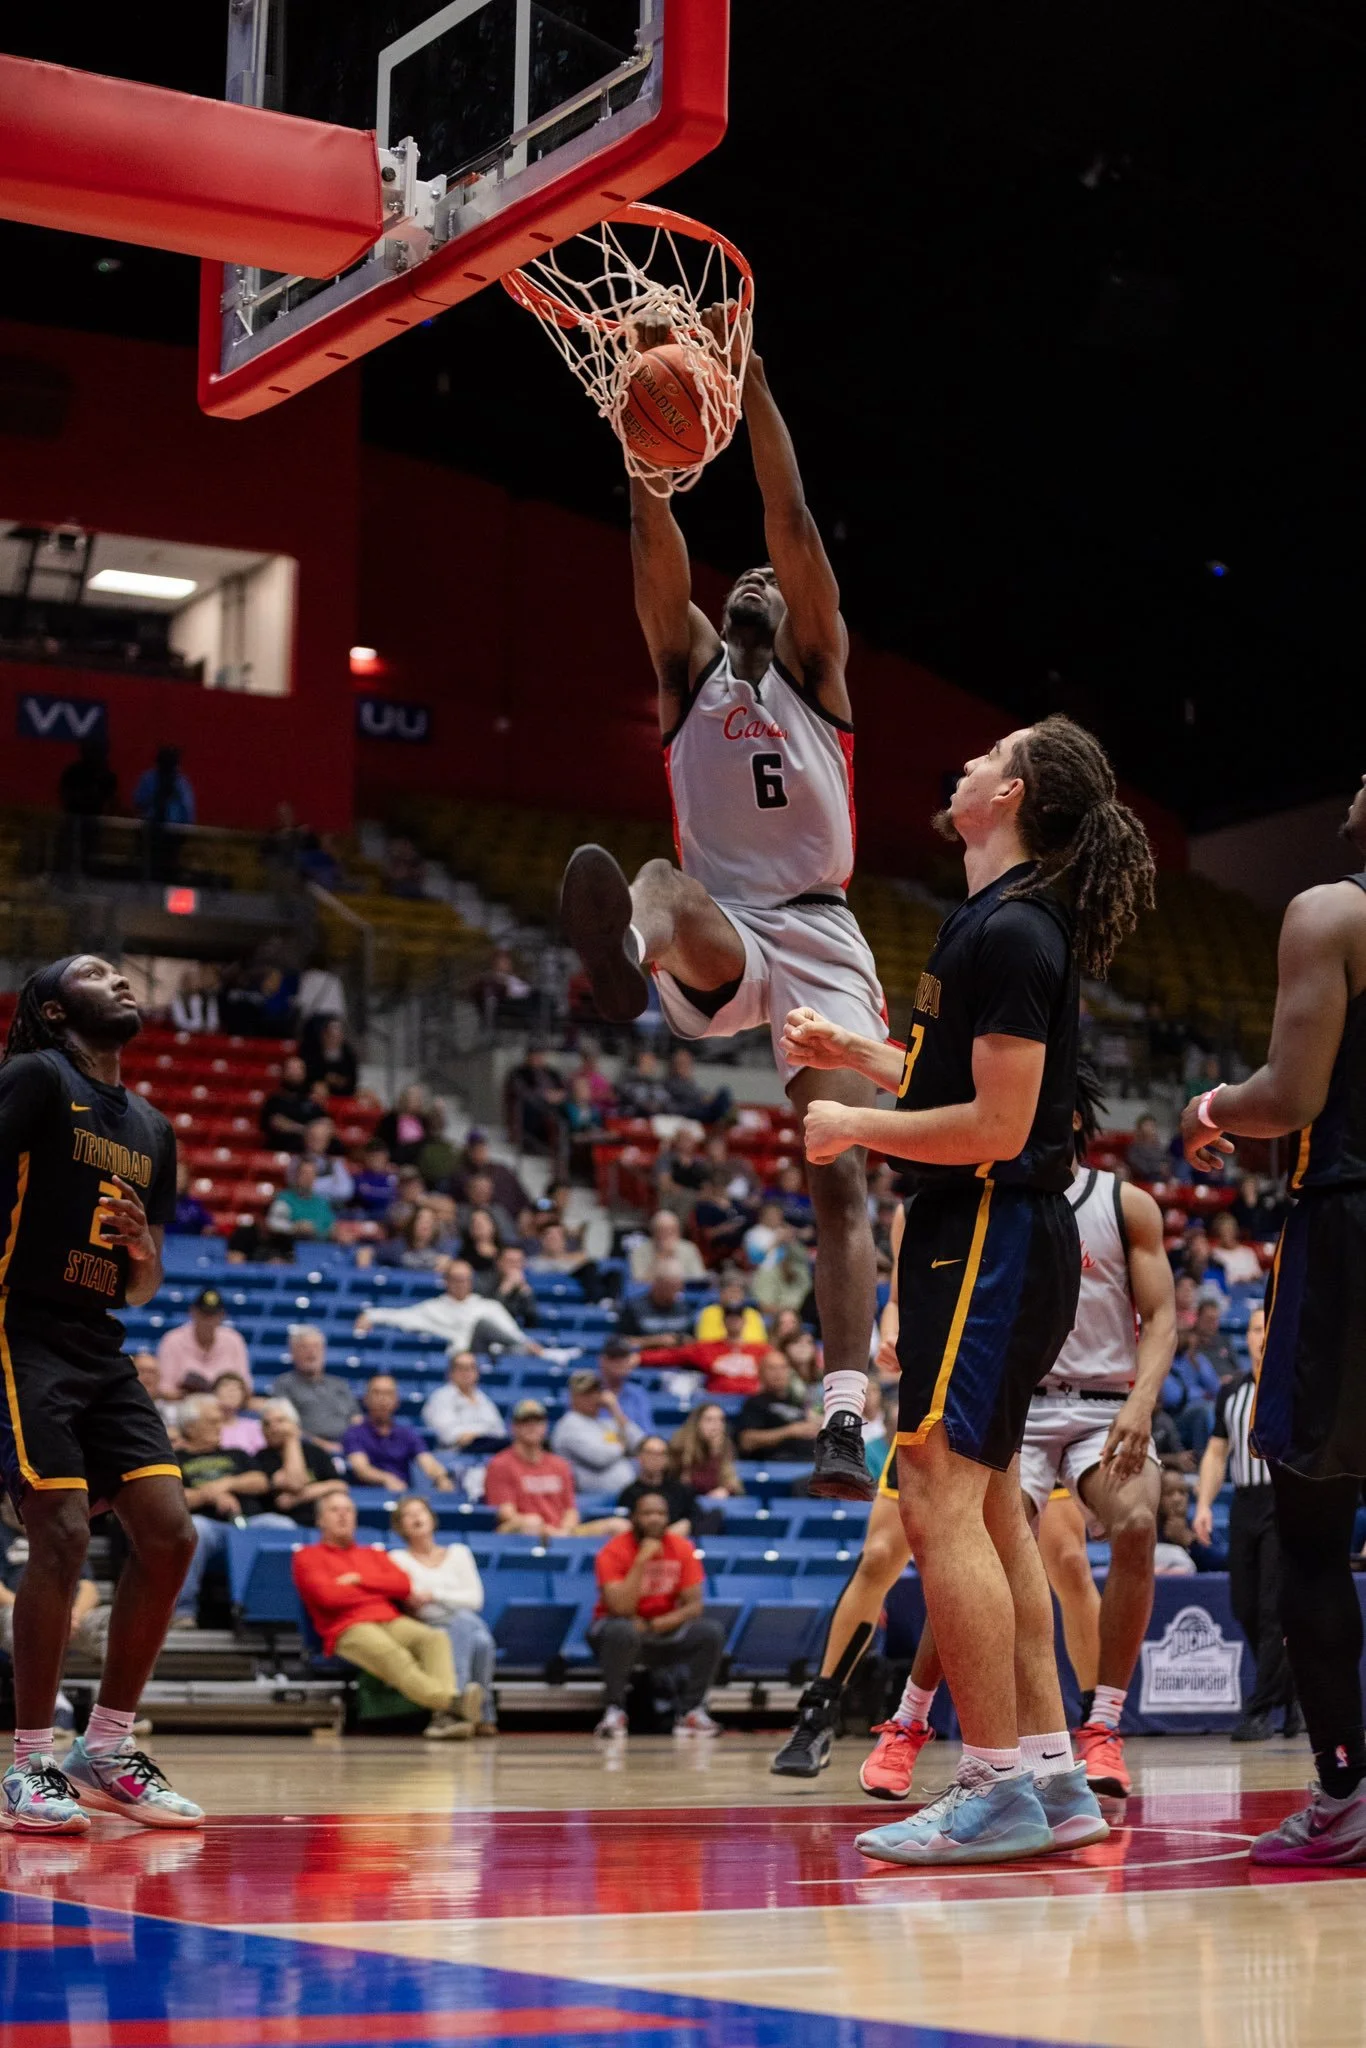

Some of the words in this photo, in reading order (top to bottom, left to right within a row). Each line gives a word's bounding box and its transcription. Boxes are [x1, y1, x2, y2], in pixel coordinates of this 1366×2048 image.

[633, 364, 692, 436] SPALDING
[24, 697, 102, 738] VV
[360, 701, 428, 738] UU
[750, 751, 789, 811] 6
[73, 1127, 153, 1188] TRINIDAD
[89, 1180, 123, 1250] 2
[64, 1250, 119, 1297] STATE
[1154, 1673, 1228, 1691] CHAMPIONSHIP
